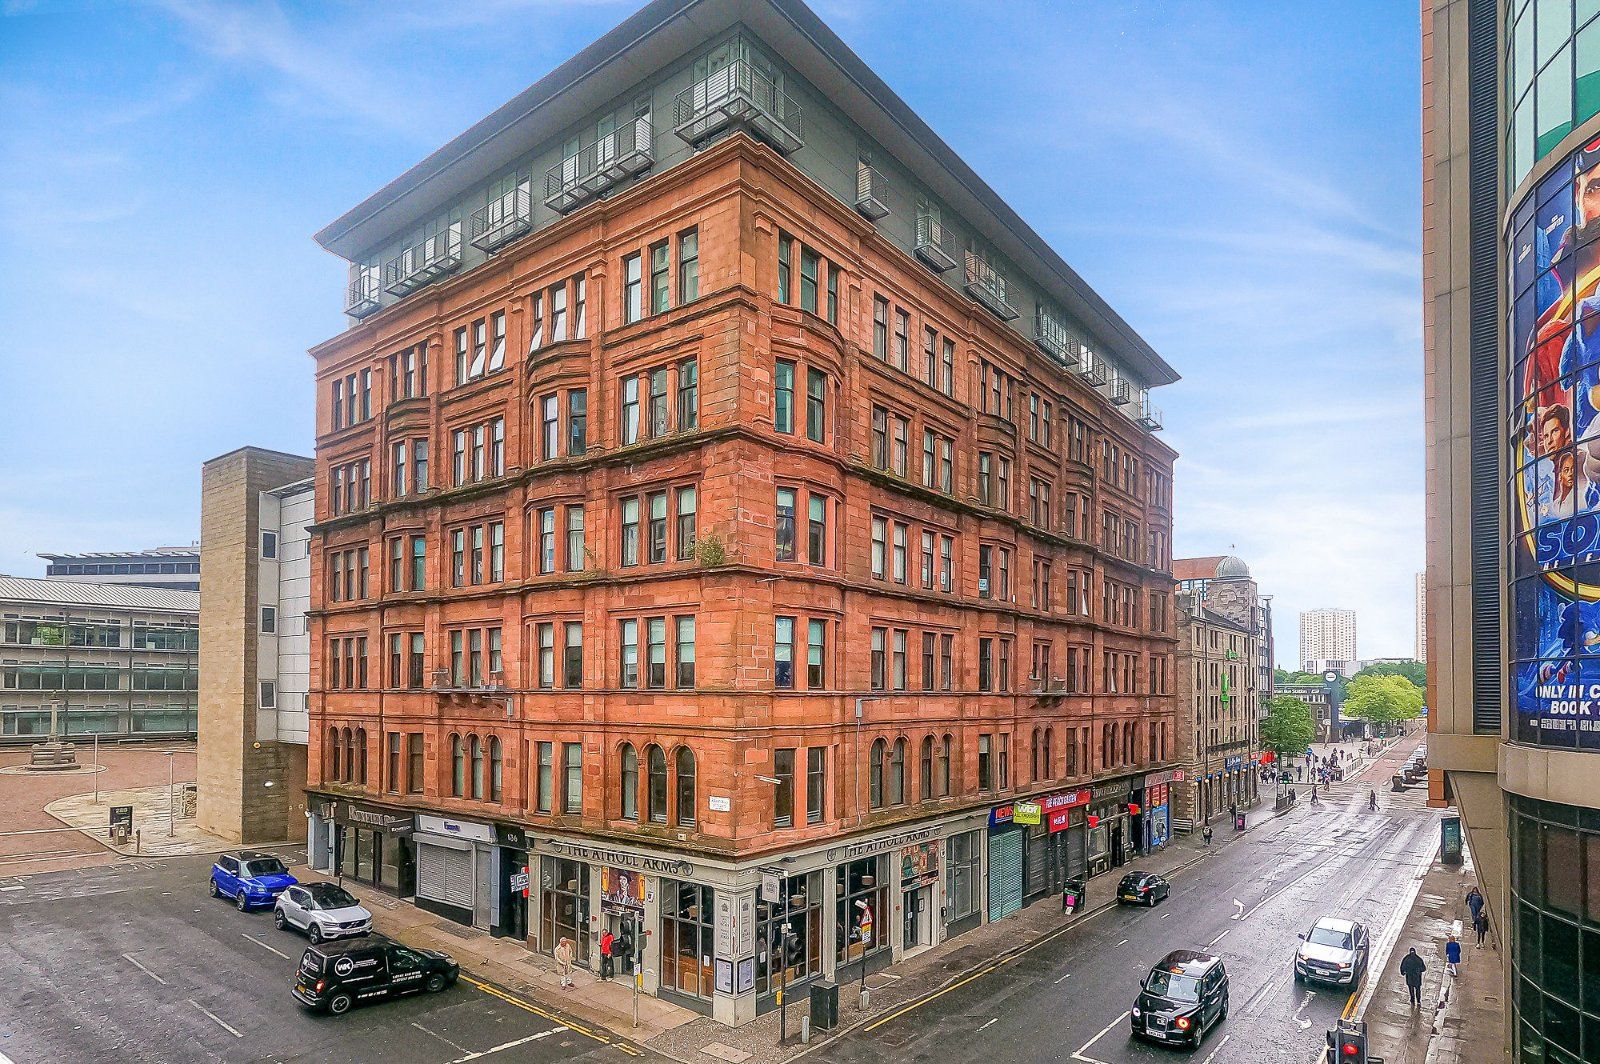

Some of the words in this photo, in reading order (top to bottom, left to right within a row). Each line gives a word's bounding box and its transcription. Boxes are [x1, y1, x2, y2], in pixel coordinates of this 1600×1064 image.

[1551, 700, 1592, 715] BOOK
[567, 845, 588, 857] THE
[591, 848, 639, 866] ATHOLL
[643, 858, 679, 874] ARMS
[843, 846, 863, 858] THE
